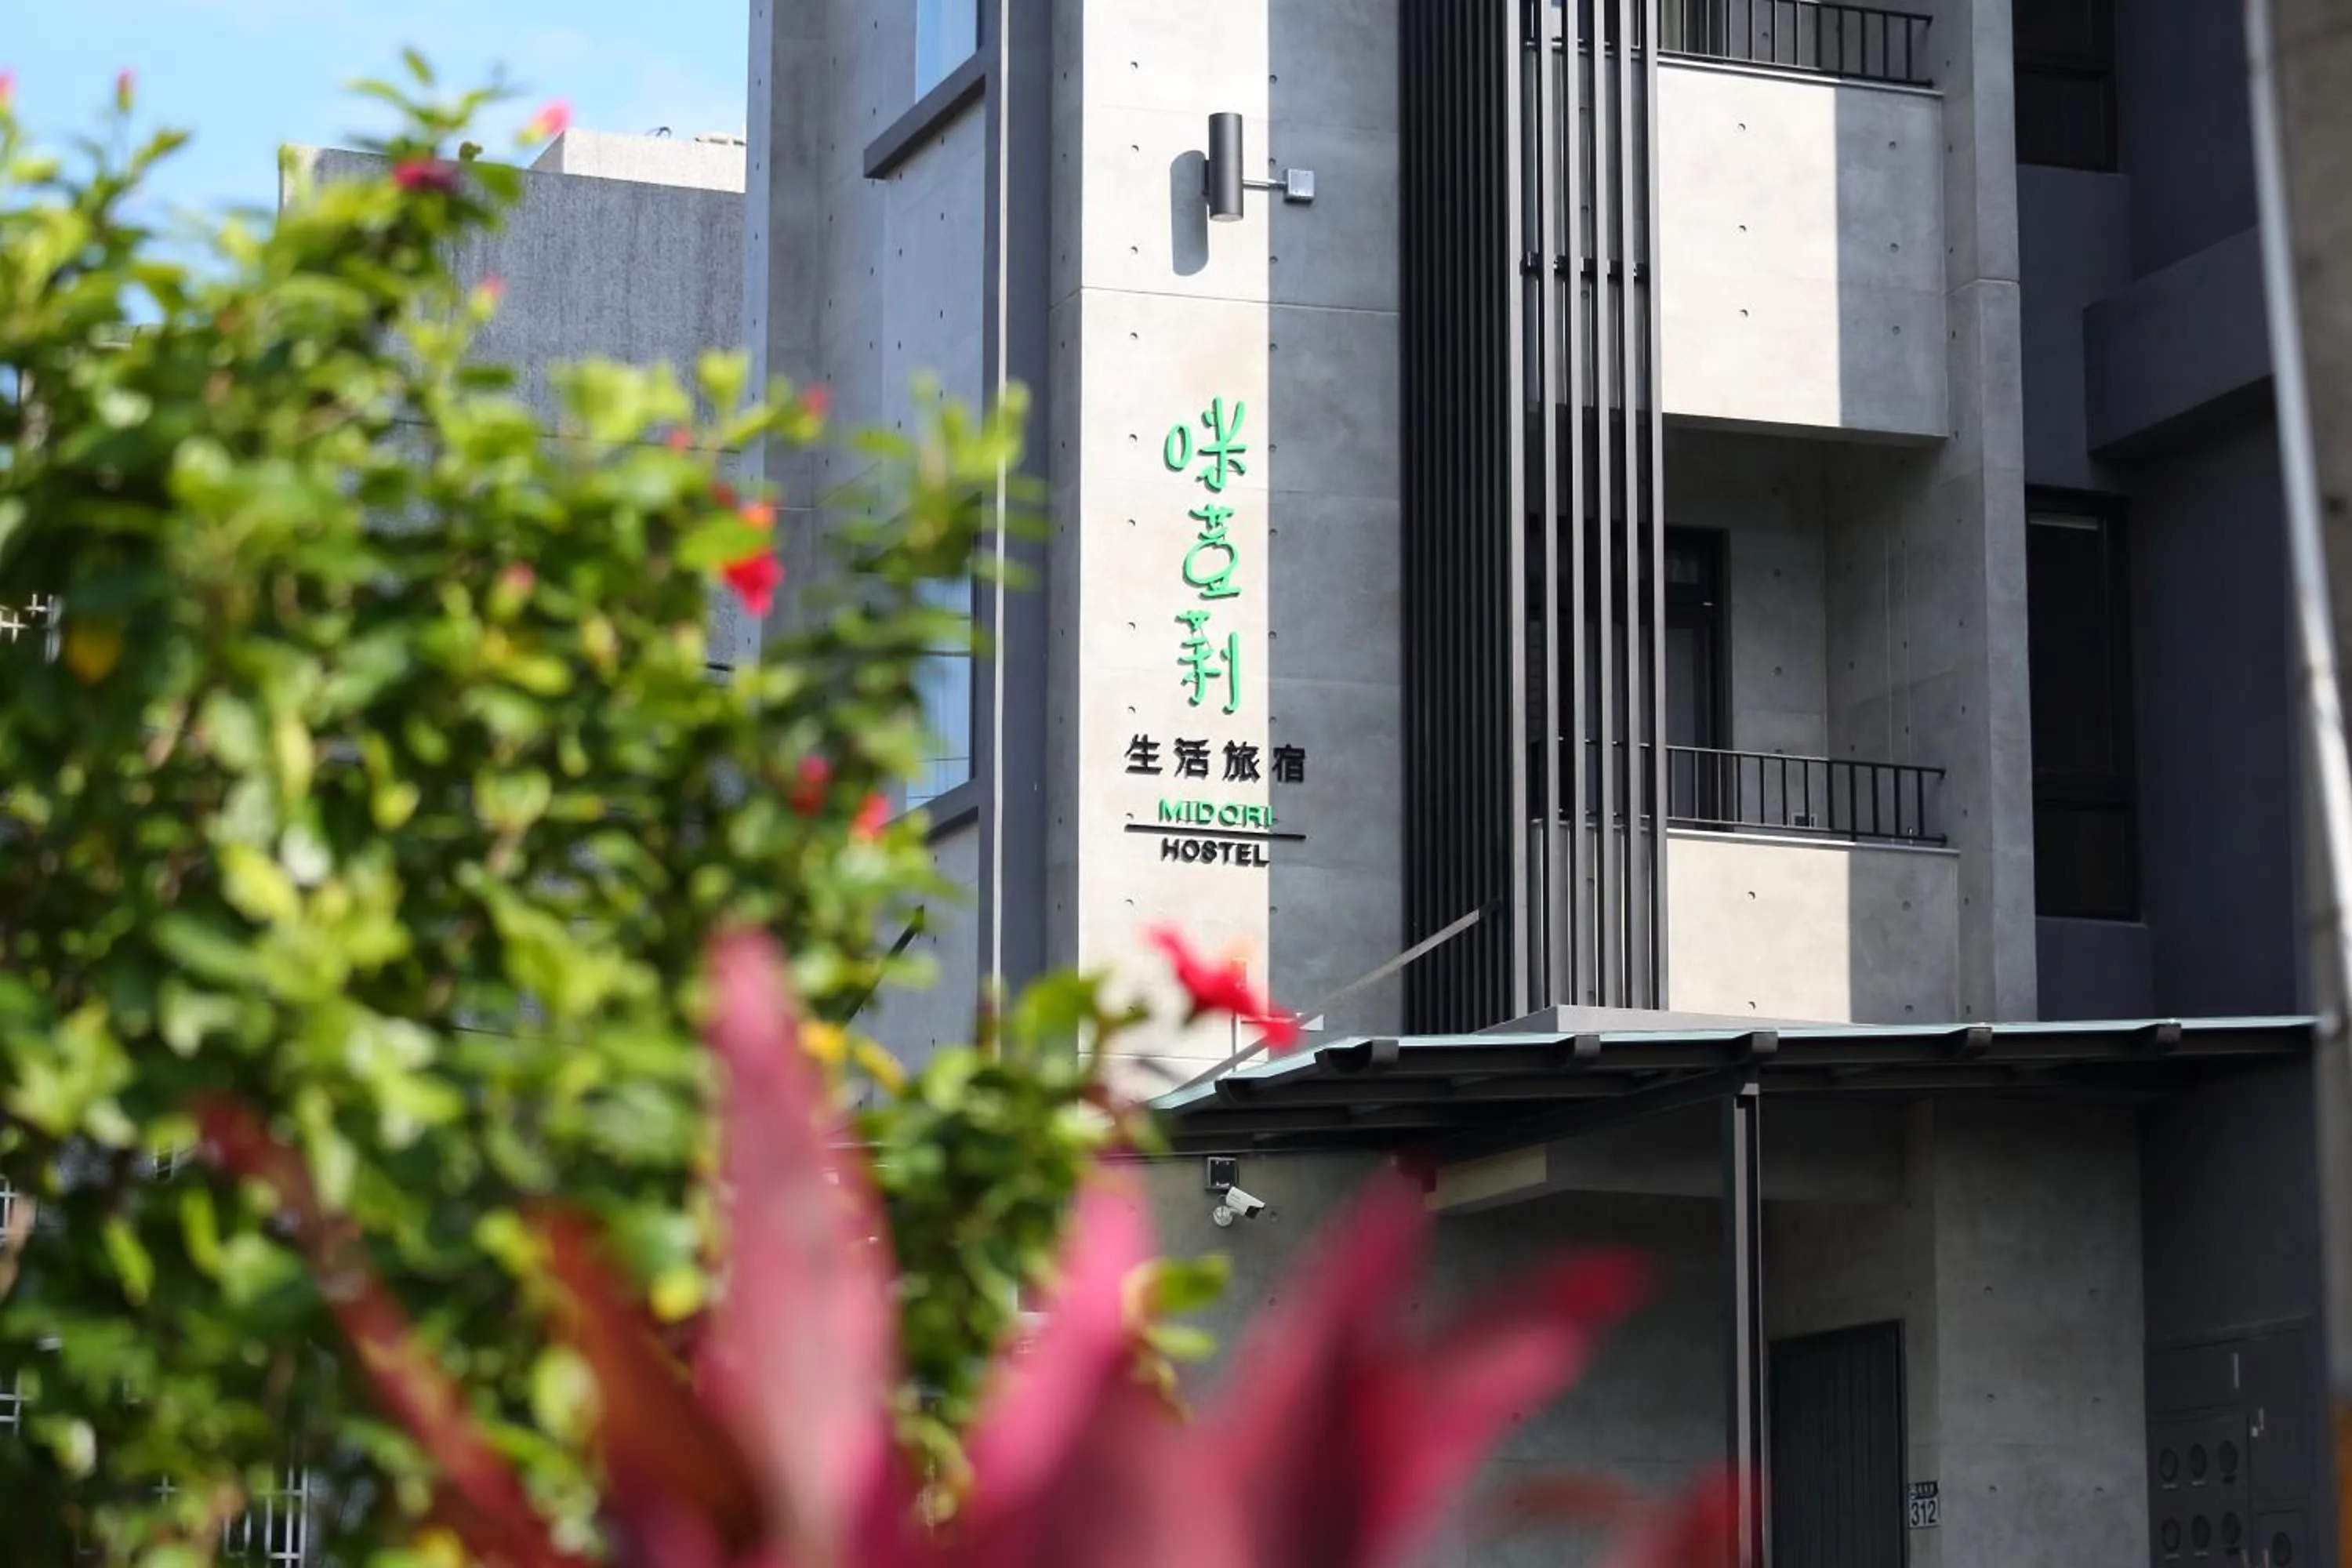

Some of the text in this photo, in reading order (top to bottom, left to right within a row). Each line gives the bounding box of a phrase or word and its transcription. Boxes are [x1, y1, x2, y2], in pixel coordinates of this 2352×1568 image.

[1125, 733, 1305, 783] 生活旅宿
[1158, 798, 1274, 828] MIDORI
[1161, 837, 1269, 866] HOSTEL
[1911, 1500, 1937, 1526] 312
